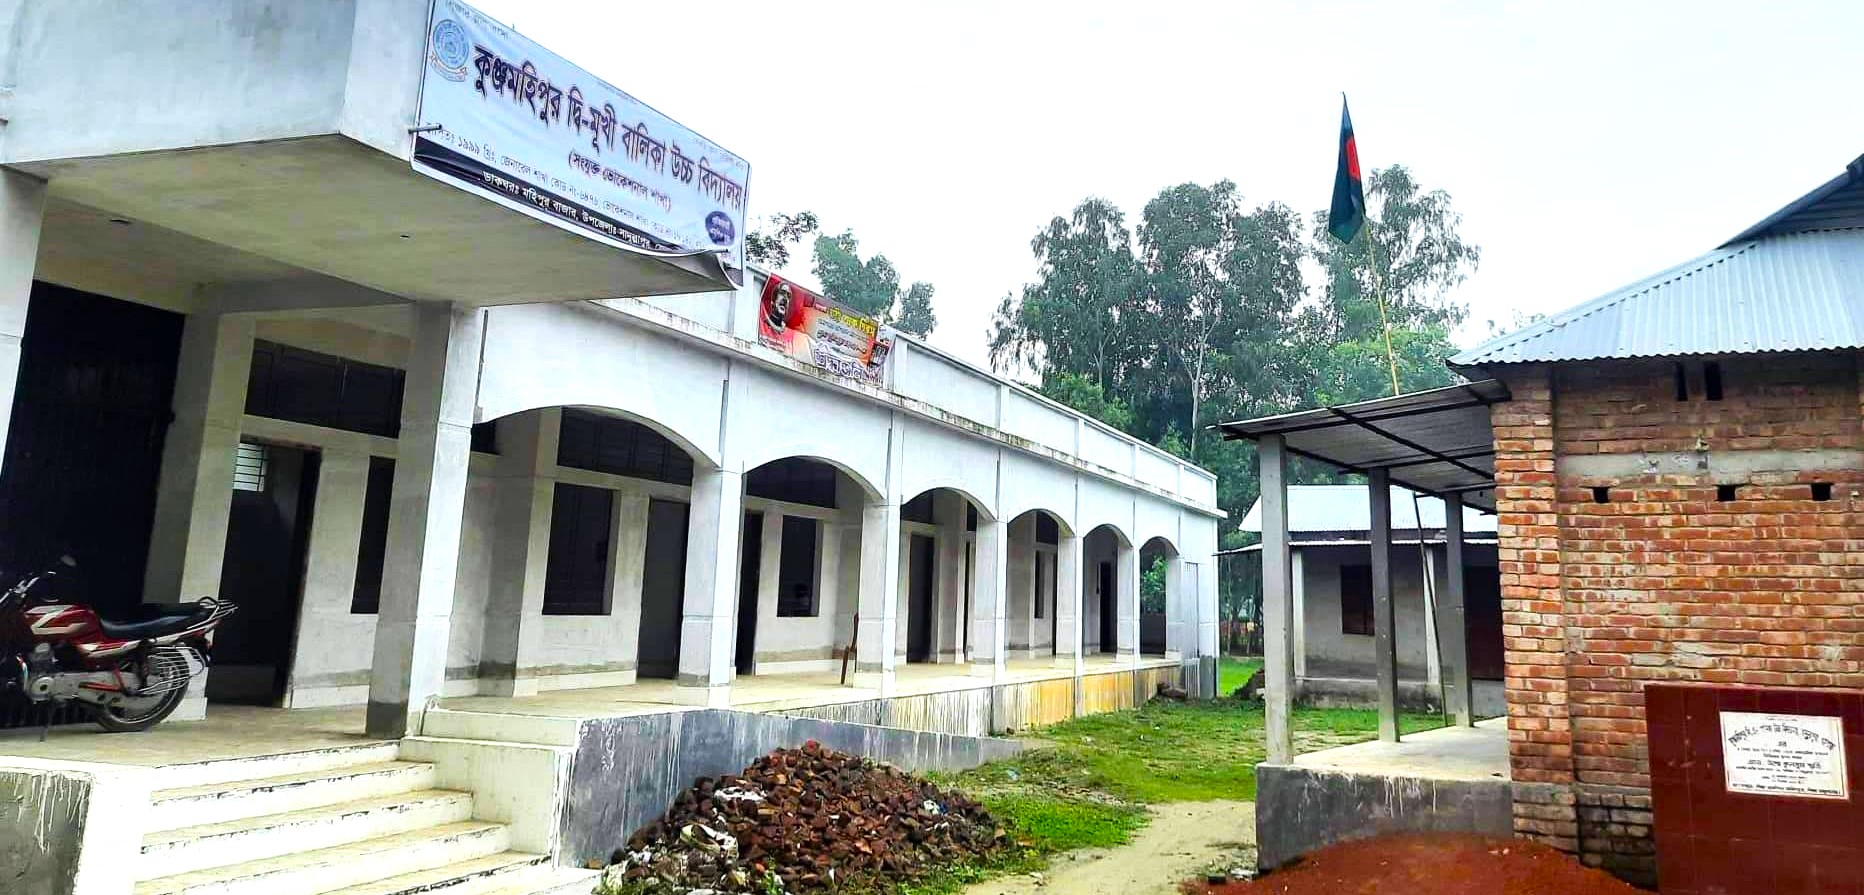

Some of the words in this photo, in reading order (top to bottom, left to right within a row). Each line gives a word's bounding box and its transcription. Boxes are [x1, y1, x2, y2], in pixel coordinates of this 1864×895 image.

[603, 167, 648, 198] ভোকেশনাল
[622, 122, 667, 174] বালিকা
[670, 140, 695, 184] উচ্চ
[698, 157, 743, 211] বিদ্যালয়
